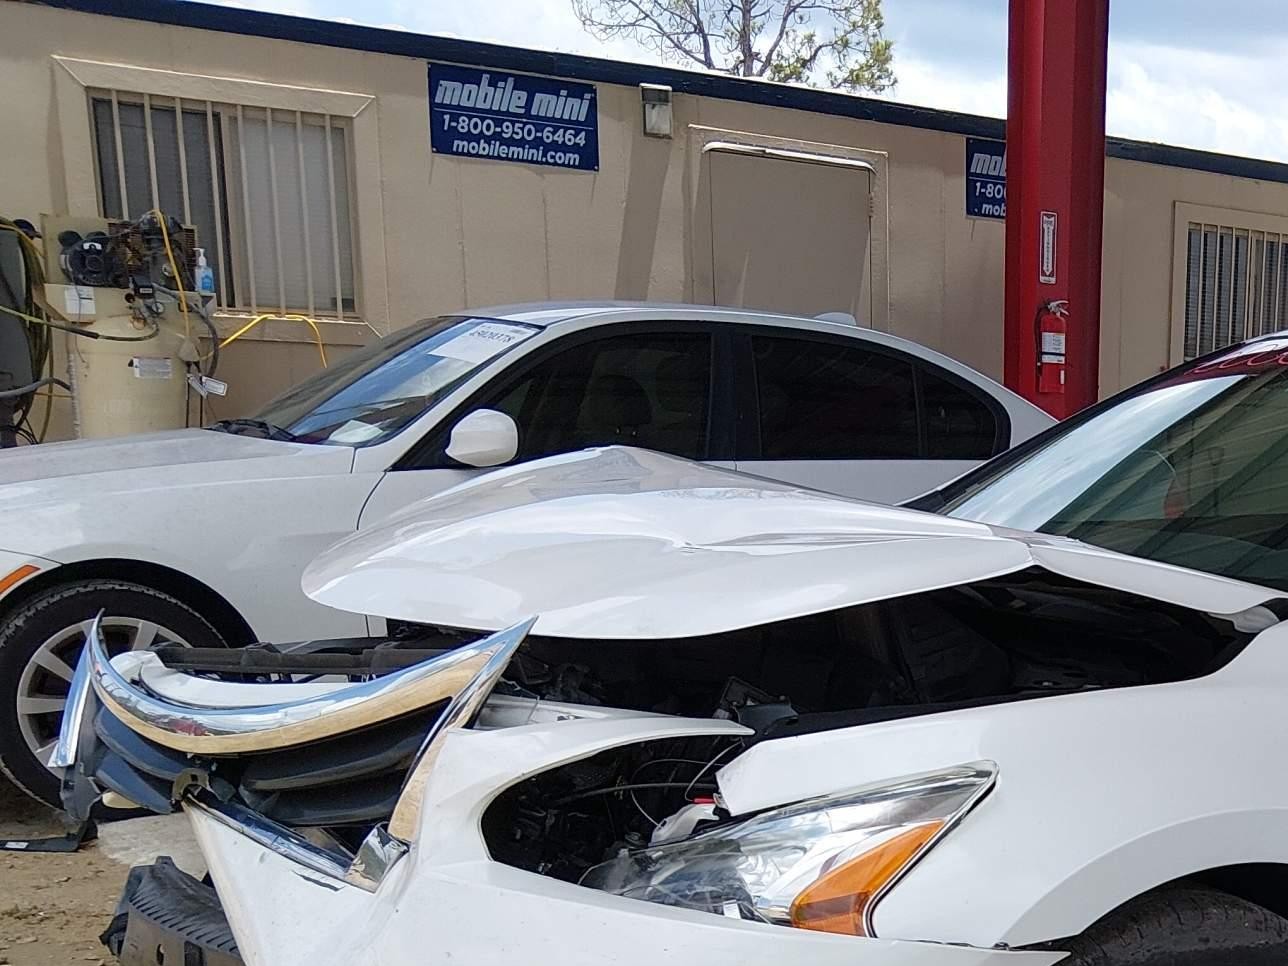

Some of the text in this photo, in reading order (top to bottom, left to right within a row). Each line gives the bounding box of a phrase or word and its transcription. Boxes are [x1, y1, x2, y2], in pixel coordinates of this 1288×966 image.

[435, 73, 592, 122] mobile mini
[443, 114, 586, 147] 1-800-950-6464
[453, 139, 580, 166] mobilemini.com
[975, 182, 1007, 199] 1-80
